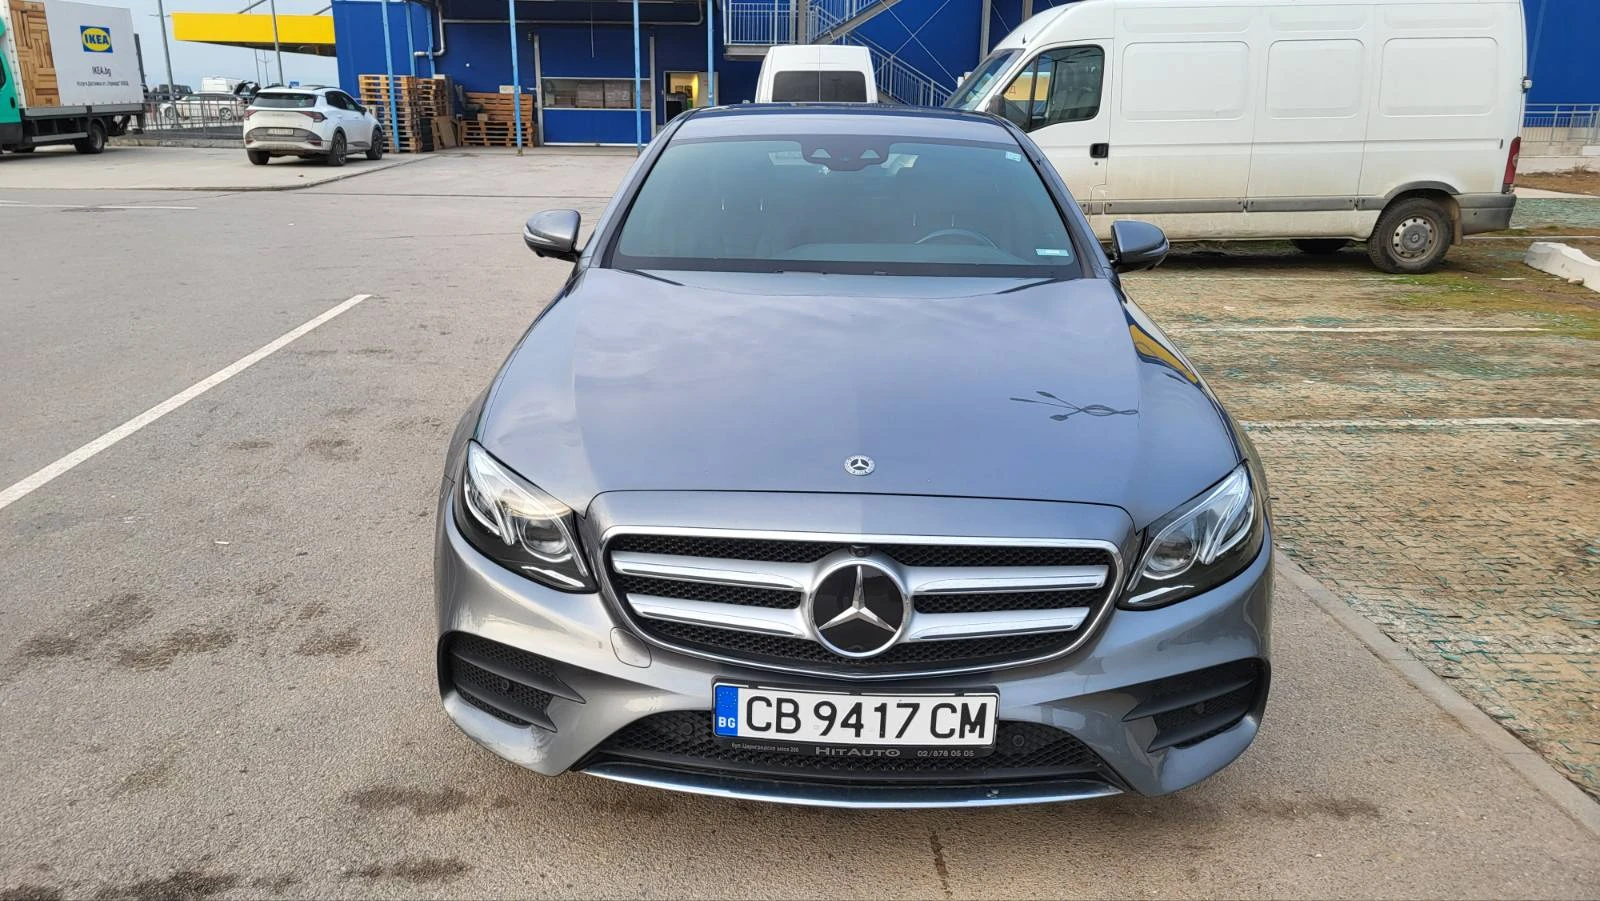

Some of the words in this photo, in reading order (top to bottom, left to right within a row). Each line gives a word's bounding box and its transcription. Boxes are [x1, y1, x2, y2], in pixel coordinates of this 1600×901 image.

[84, 33, 110, 45] IKEA
[718, 716, 736, 729] BG
[746, 696, 801, 734] CB
[813, 701, 921, 738] 9417
[930, 702, 988, 739] CM
